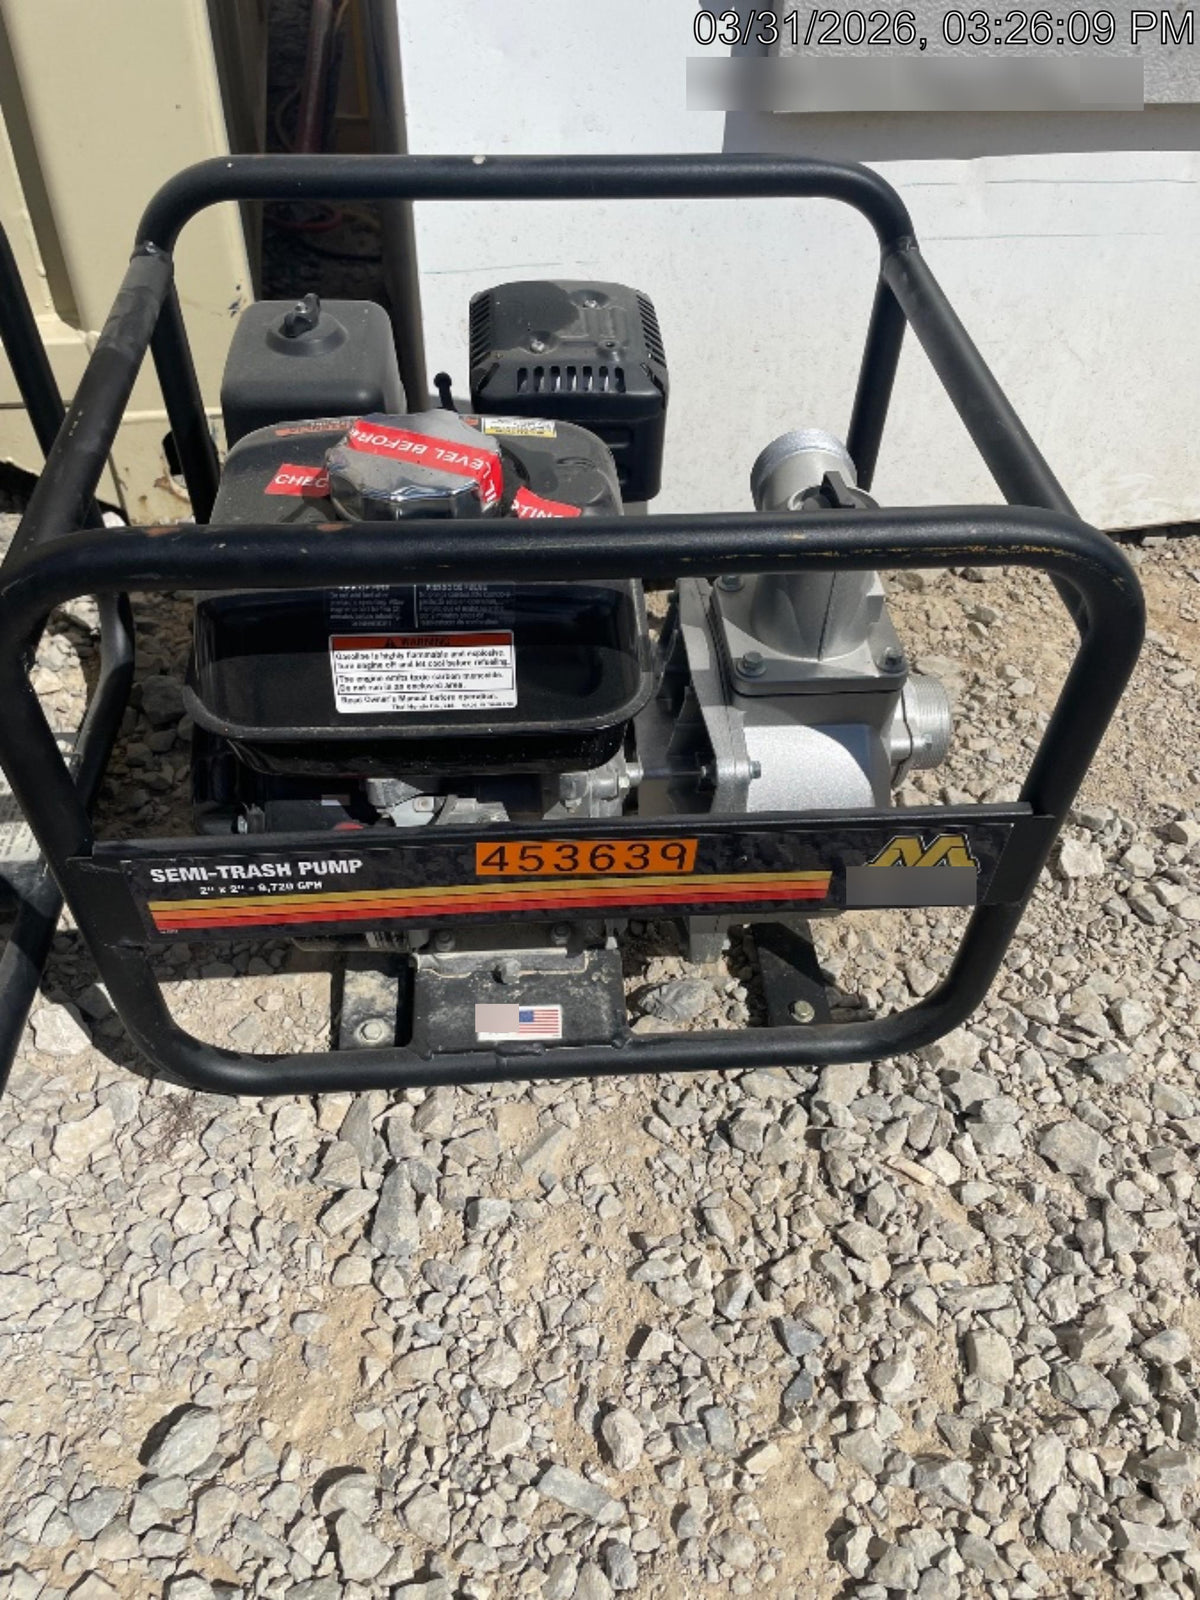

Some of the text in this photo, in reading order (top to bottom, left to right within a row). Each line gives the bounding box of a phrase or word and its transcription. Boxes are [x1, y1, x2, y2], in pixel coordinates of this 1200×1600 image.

[480, 842, 688, 873] 453639
[150, 859, 363, 883] SEMI-TRASH PUMP
[297, 881, 323, 890] GPH
